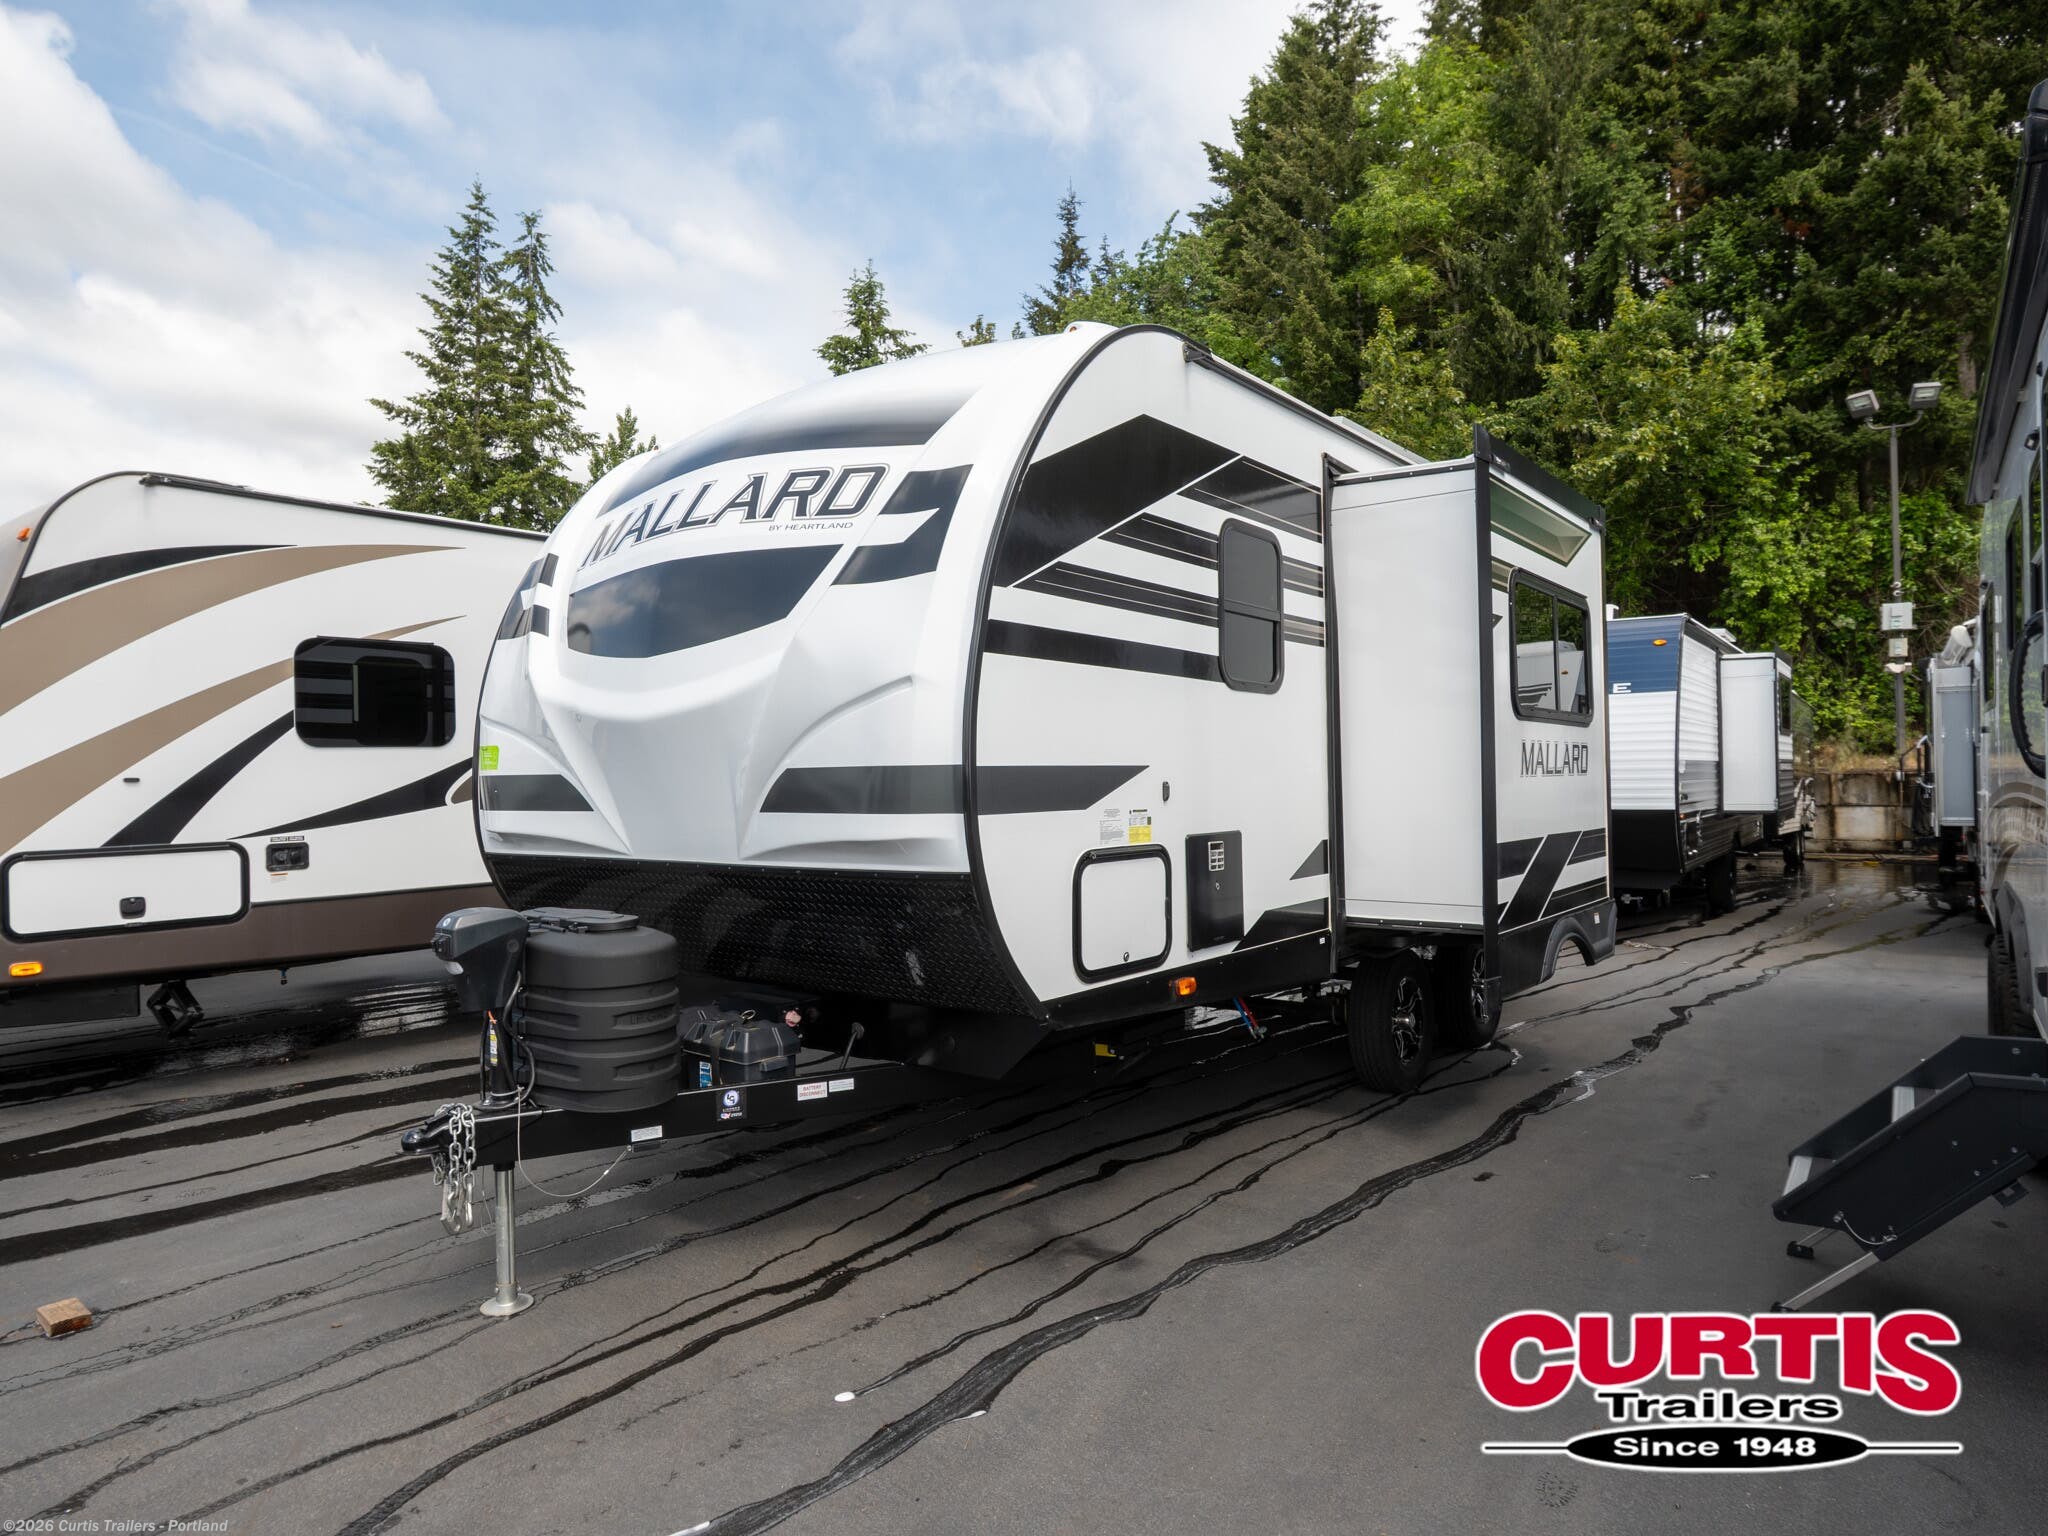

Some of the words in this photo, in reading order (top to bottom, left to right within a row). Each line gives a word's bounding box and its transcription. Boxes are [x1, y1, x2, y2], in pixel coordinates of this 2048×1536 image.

[576, 463, 890, 572] MALLARD
[785, 522, 854, 531] HEARTLAND
[1520, 739, 1589, 778] MALLARD
